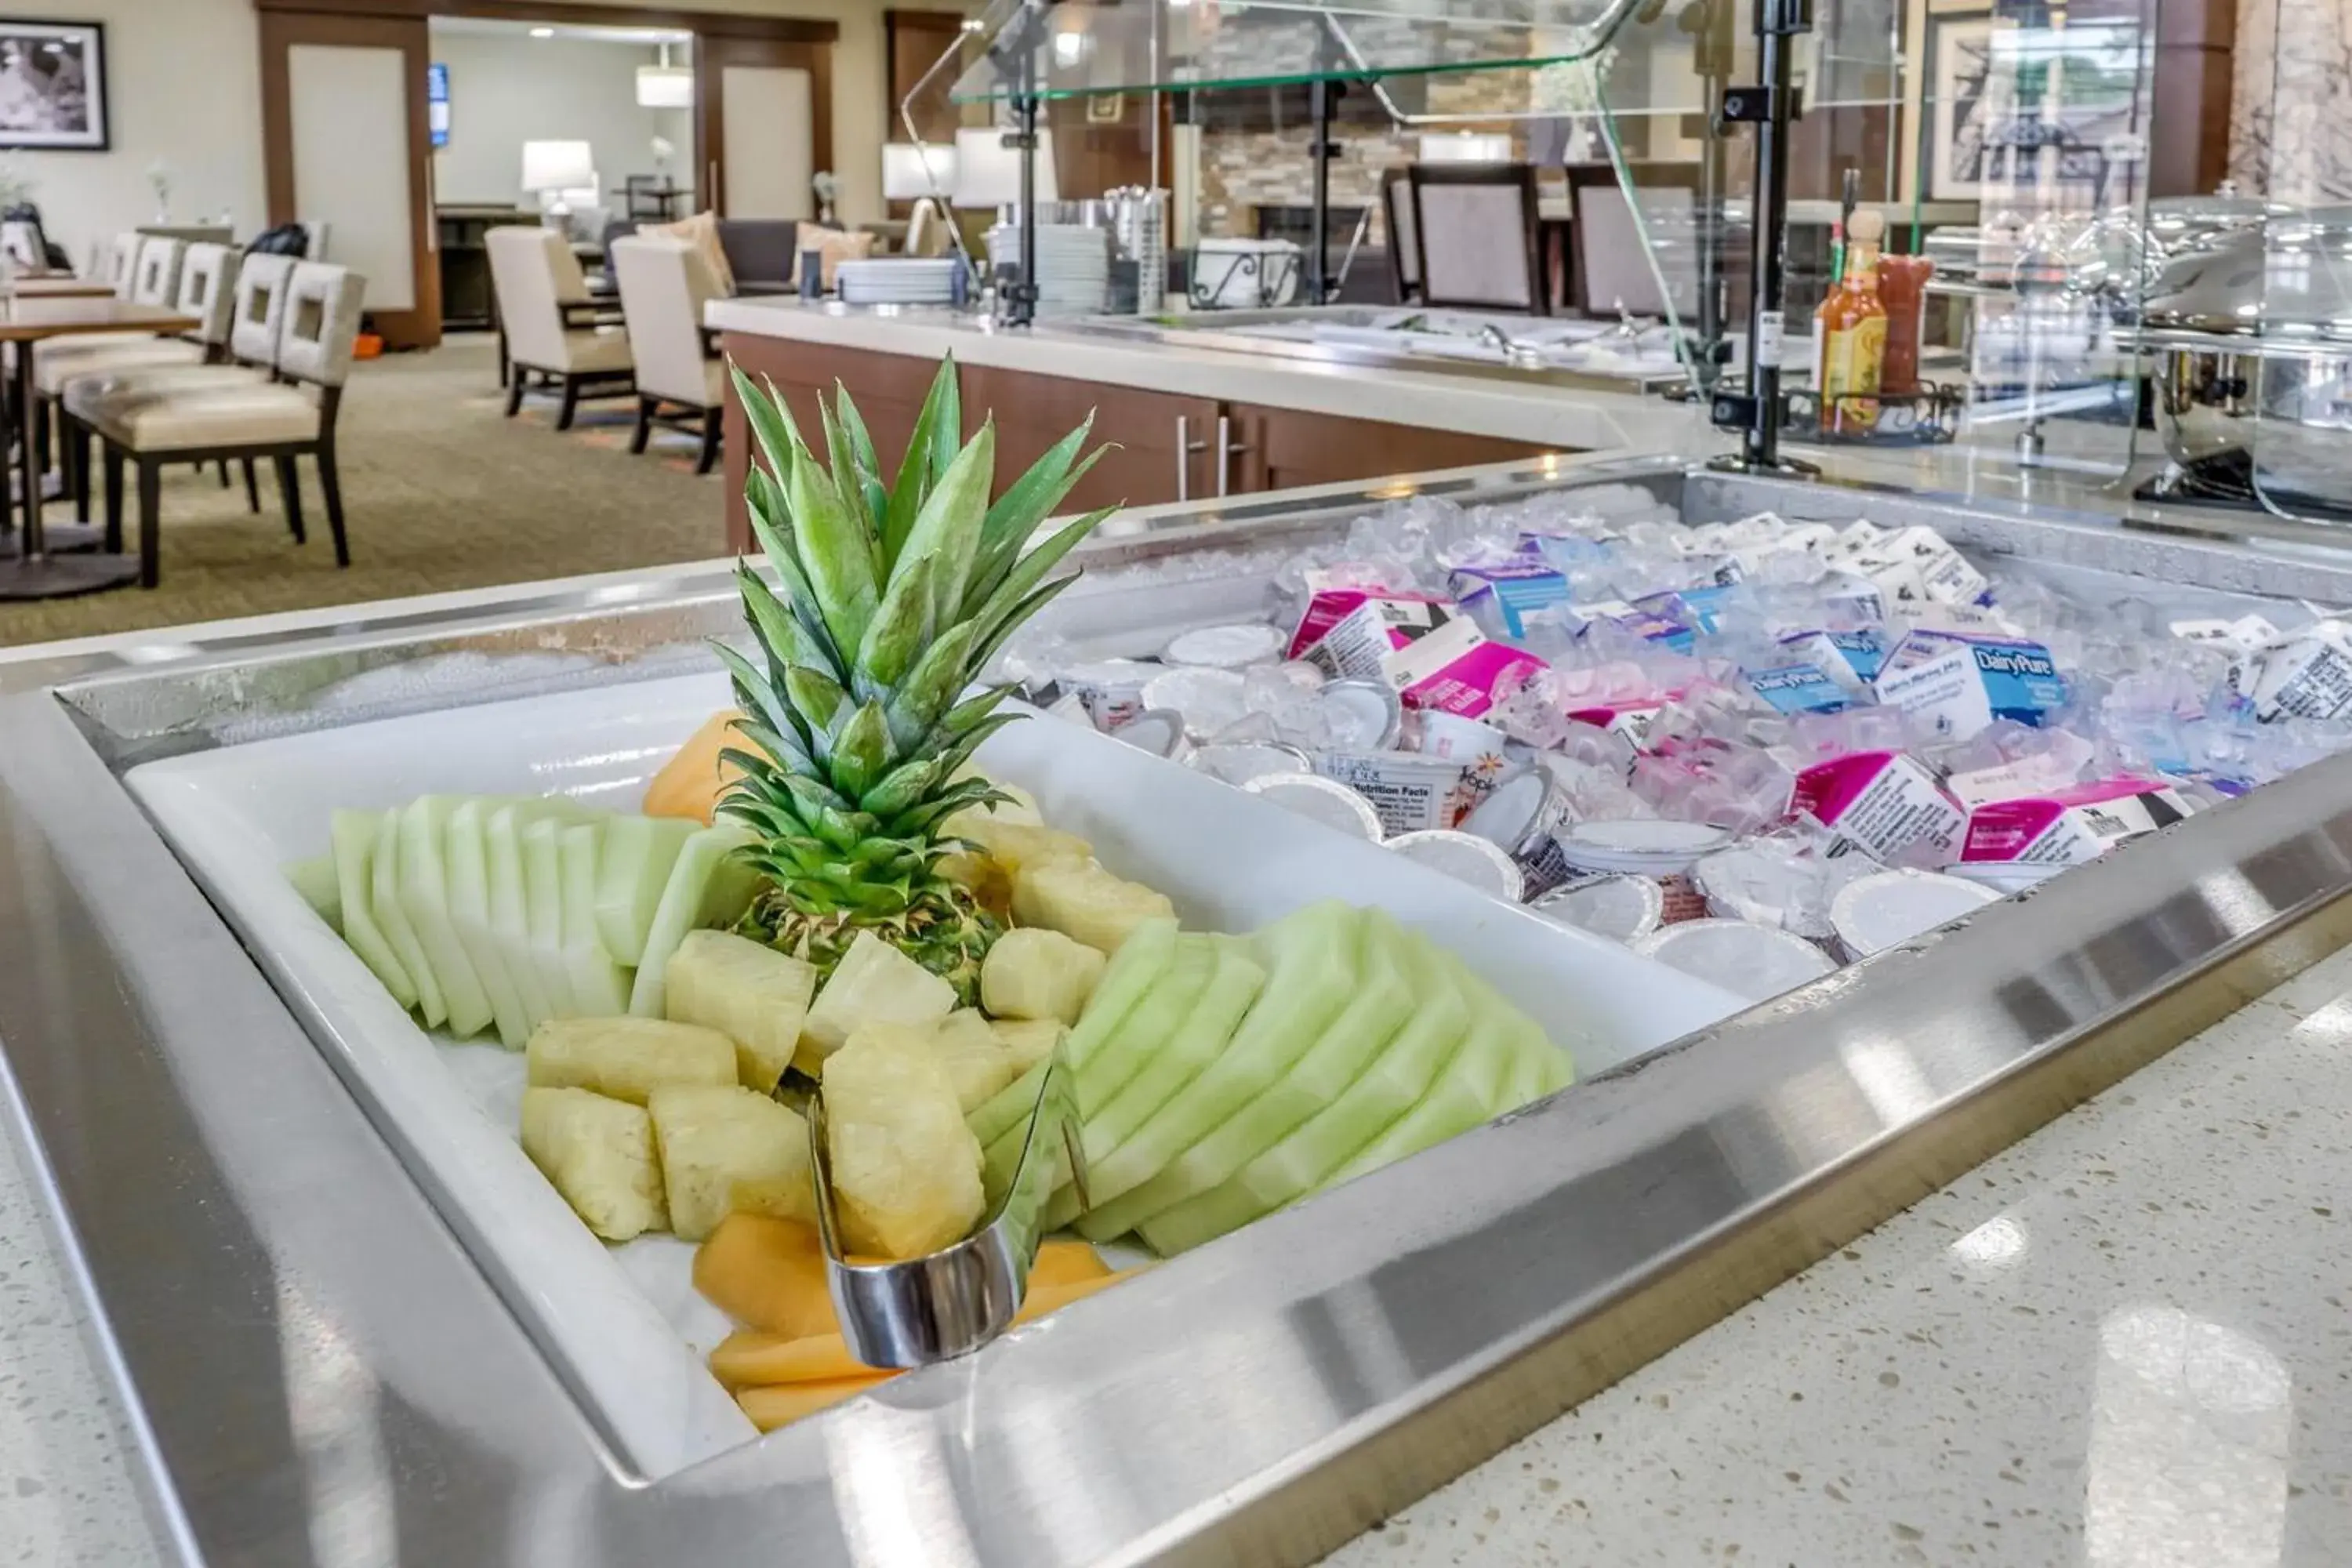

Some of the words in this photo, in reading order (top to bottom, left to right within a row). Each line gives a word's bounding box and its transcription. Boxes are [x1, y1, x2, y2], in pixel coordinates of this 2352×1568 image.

[1975, 648, 2053, 677] DairyPure
[1355, 783, 1399, 794] Nutrition
[1402, 786, 1428, 797] Facts
